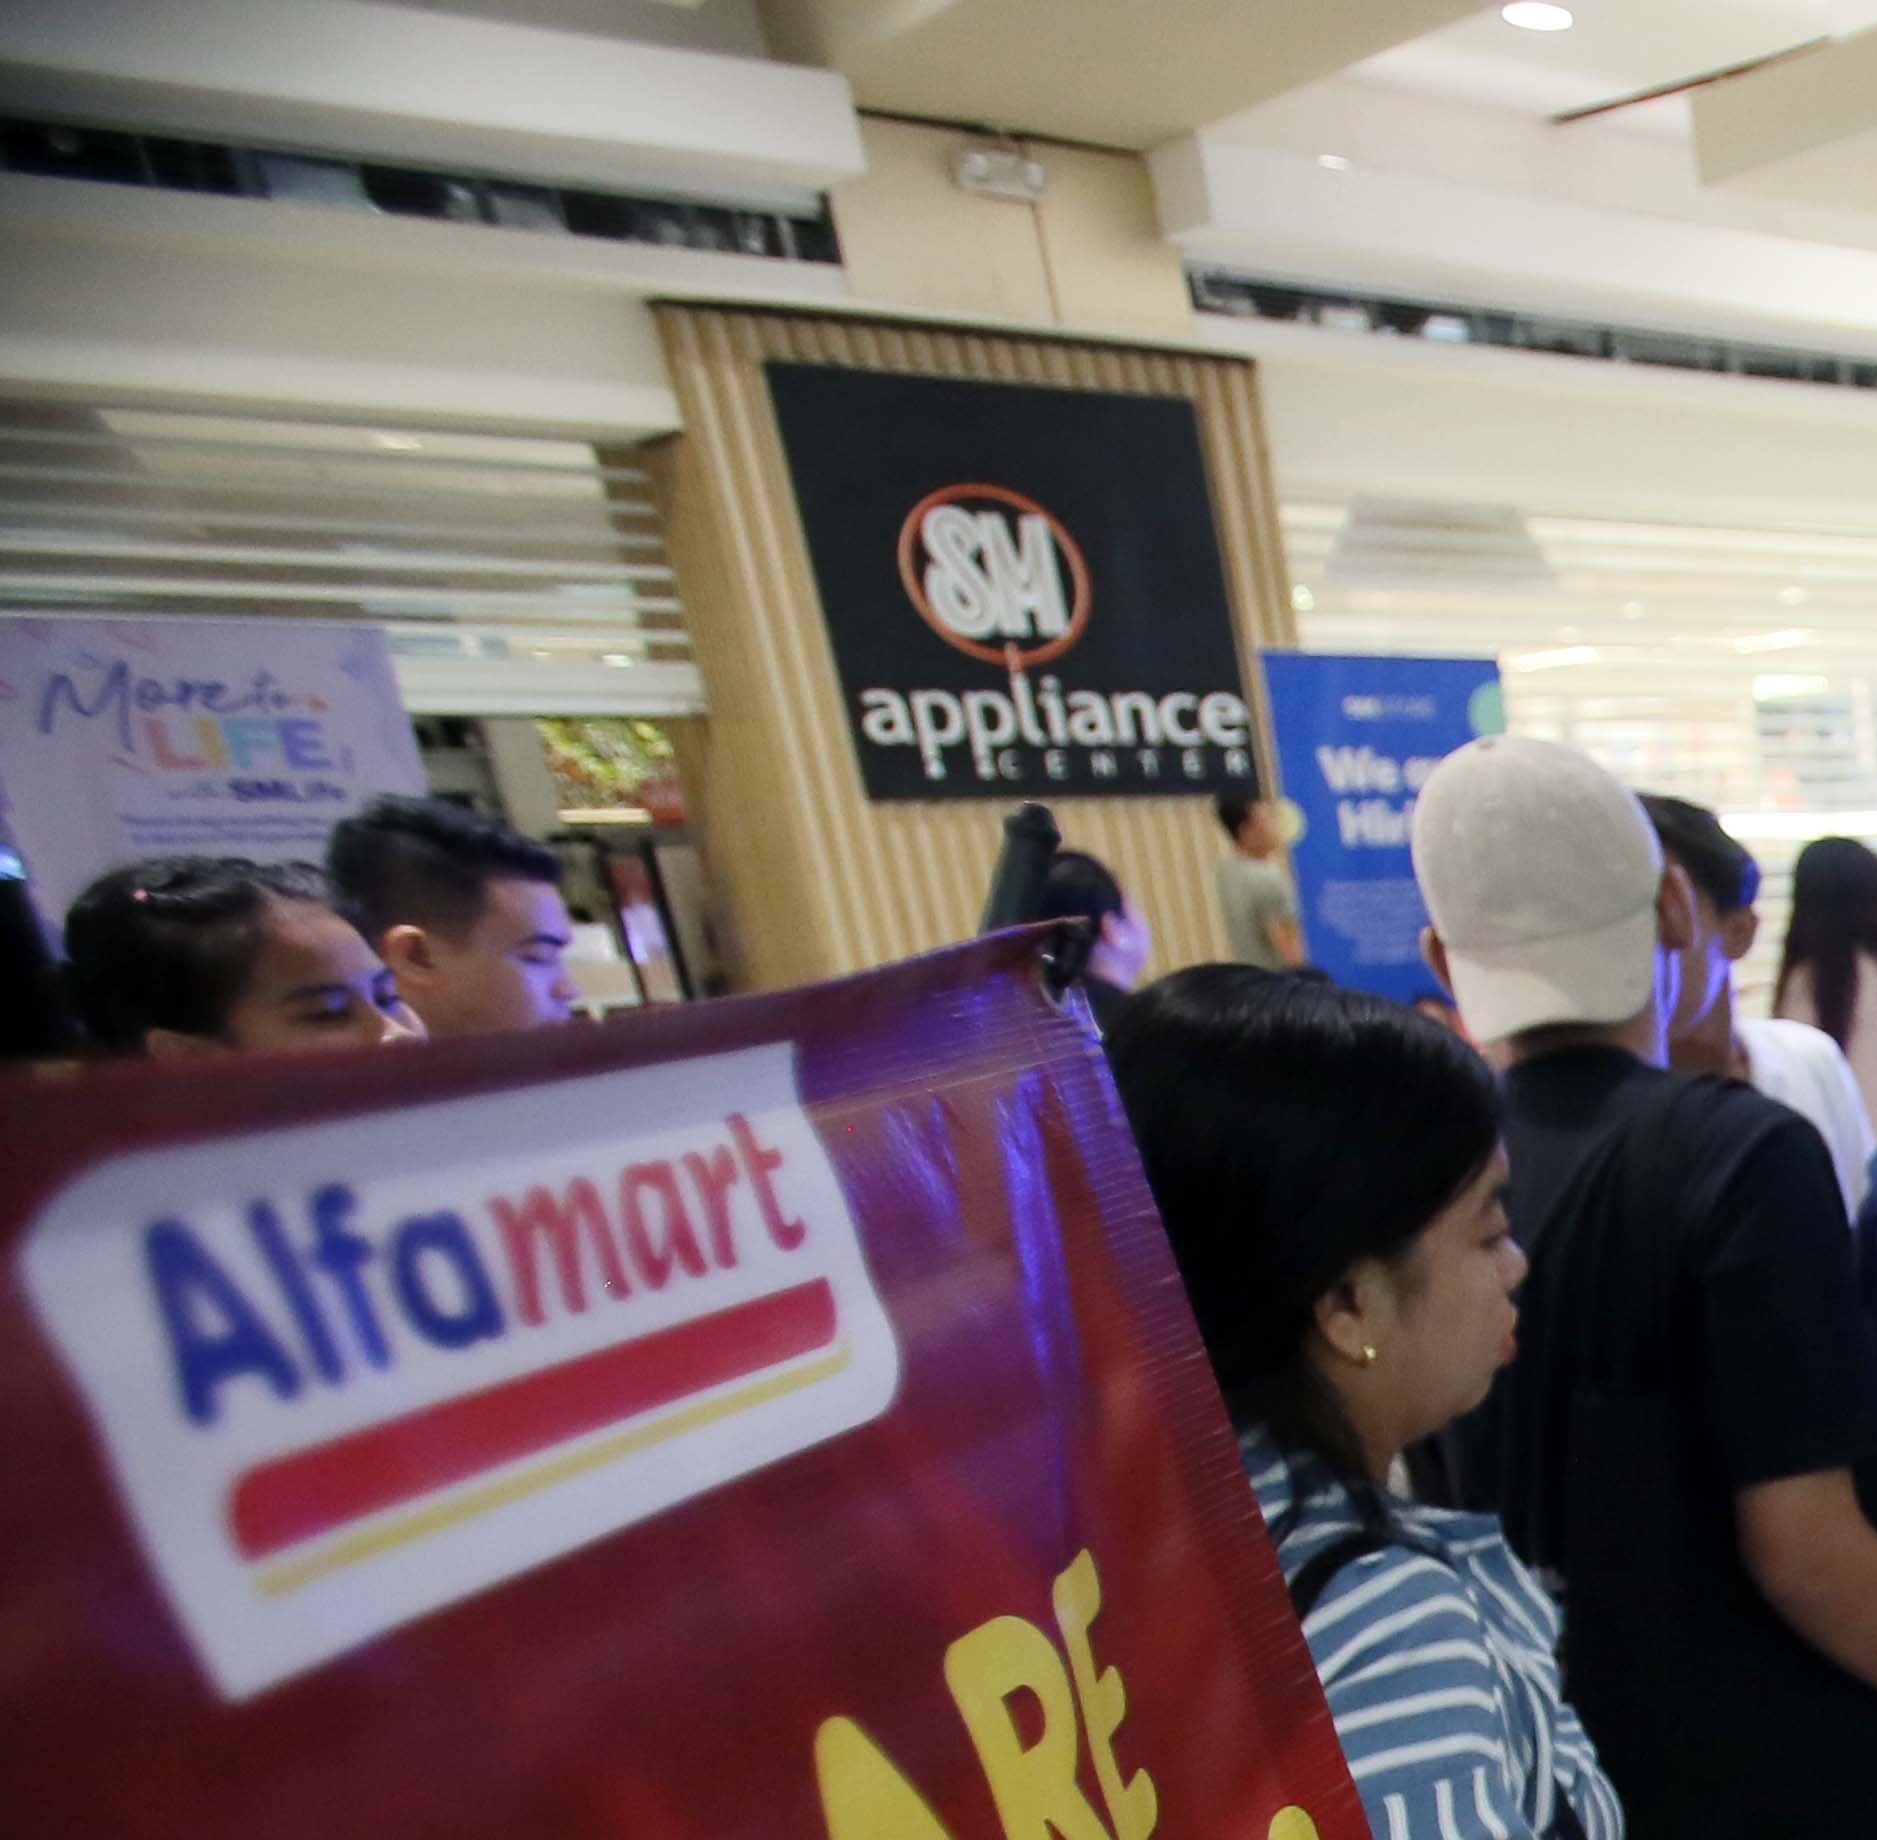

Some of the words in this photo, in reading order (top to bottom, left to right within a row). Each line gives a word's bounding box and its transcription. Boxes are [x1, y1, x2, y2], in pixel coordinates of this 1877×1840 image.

[922, 504, 1070, 640] SM
[36, 660, 228, 752] More
[143, 716, 334, 771] LIFE
[859, 668, 1252, 781] appliance
[998, 746, 1250, 780] CENTER
[1315, 746, 1399, 794] We
[137, 1110, 806, 1427] Alfamart
